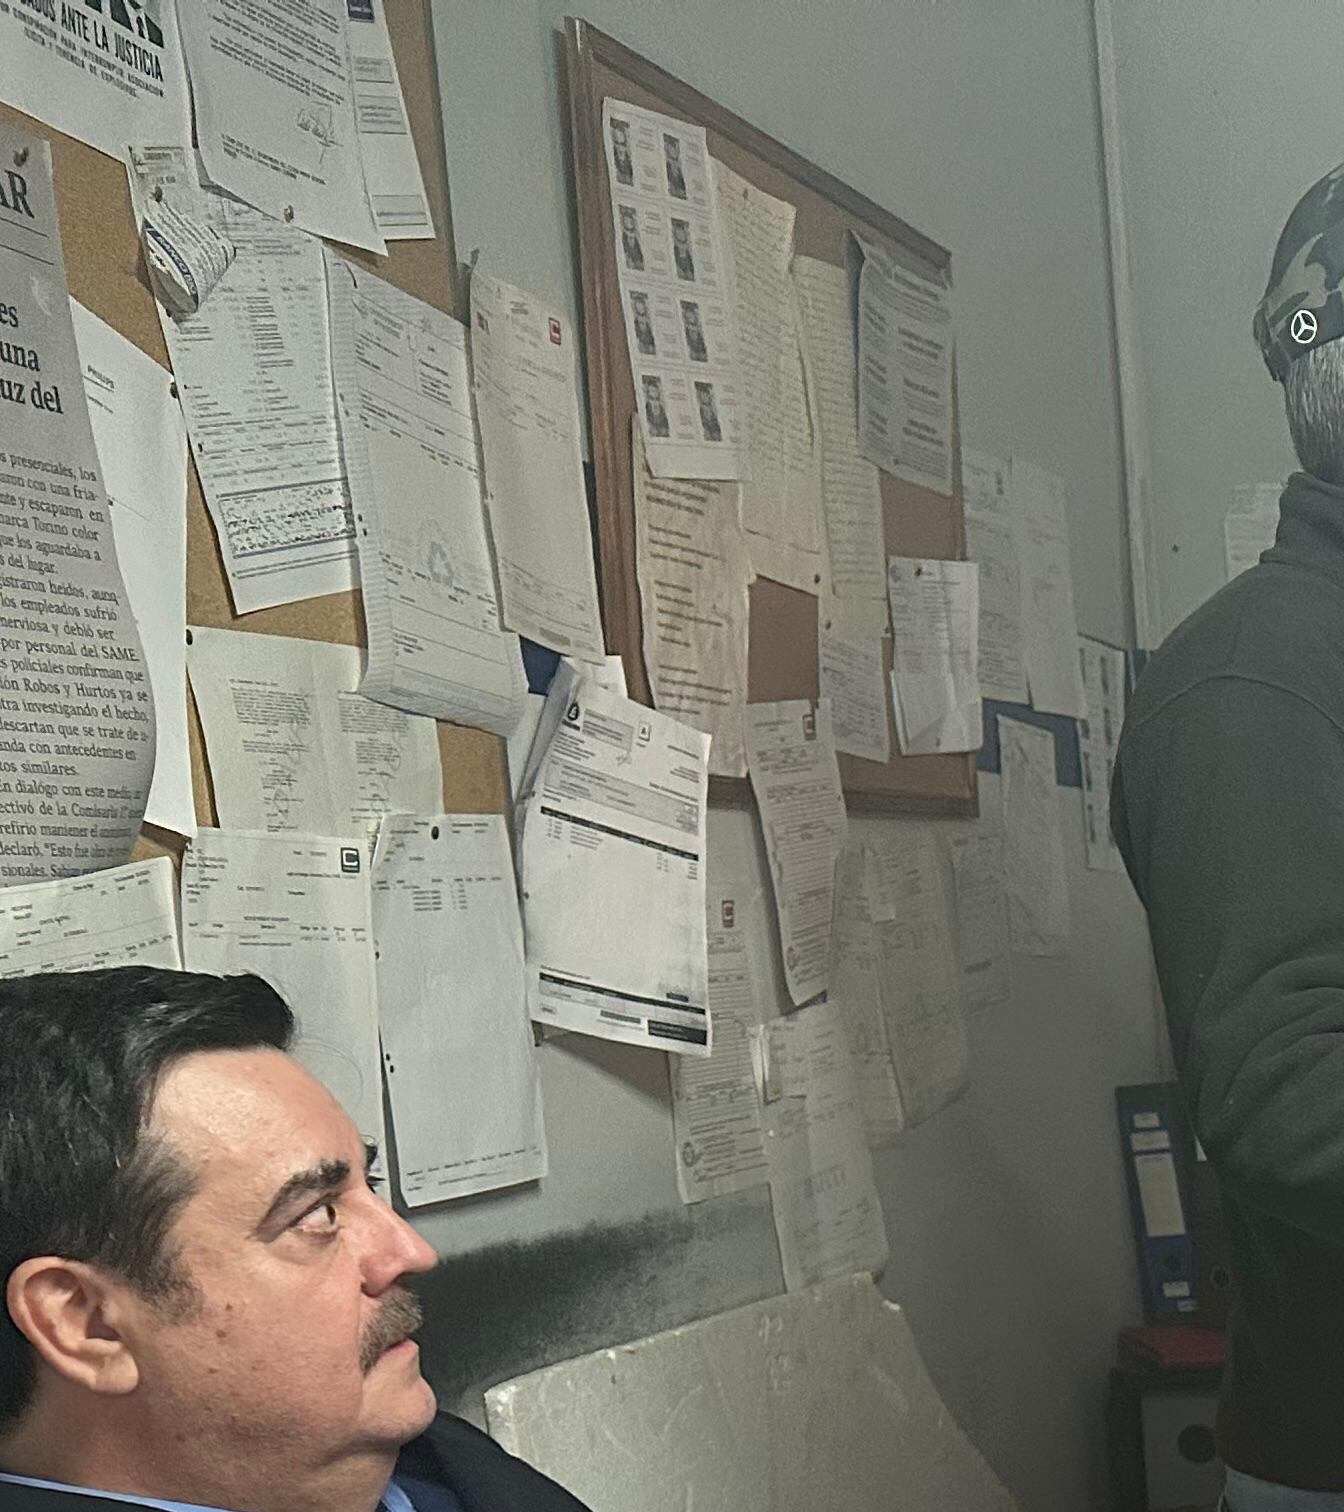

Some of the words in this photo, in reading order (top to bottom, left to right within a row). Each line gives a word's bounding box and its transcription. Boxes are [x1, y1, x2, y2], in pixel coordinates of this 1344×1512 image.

[61, 2, 90, 43] ANTE
[93, 20, 110, 53] LA
[114, 32, 164, 82] JUSTICIA
[0, 340, 40, 373] una
[31, 382, 64, 415] del
[79, 466, 97, 481] los
[89, 510, 104, 522] en
[72, 525, 99, 541] color
[21, 600, 80, 618] empleados
[52, 624, 59, 637] y
[1, 637, 21, 651] por
[25, 641, 77, 656] personal
[80, 646, 99, 659] del
[10, 657, 64, 675] policiales
[66, 663, 123, 680] confirman
[125, 671, 144, 684] que
[23, 677, 61, 694] Robos
[63, 684, 71, 697] y
[74, 682, 117, 698] Hurtos
[119, 690, 133, 703] ya
[137, 691, 149, 702] se
[22, 699, 99, 718] investigando
[101, 704, 113, 719] el
[58, 724, 79, 739] que
[83, 728, 95, 737] se
[97, 727, 124, 741] trate
[29, 741, 51, 755] con
[22, 760, 79, 776] similares.
[62, 784, 82, 797] con
[85, 787, 105, 798] este
[39, 801, 53, 815] de
[56, 801, 68, 816] la
